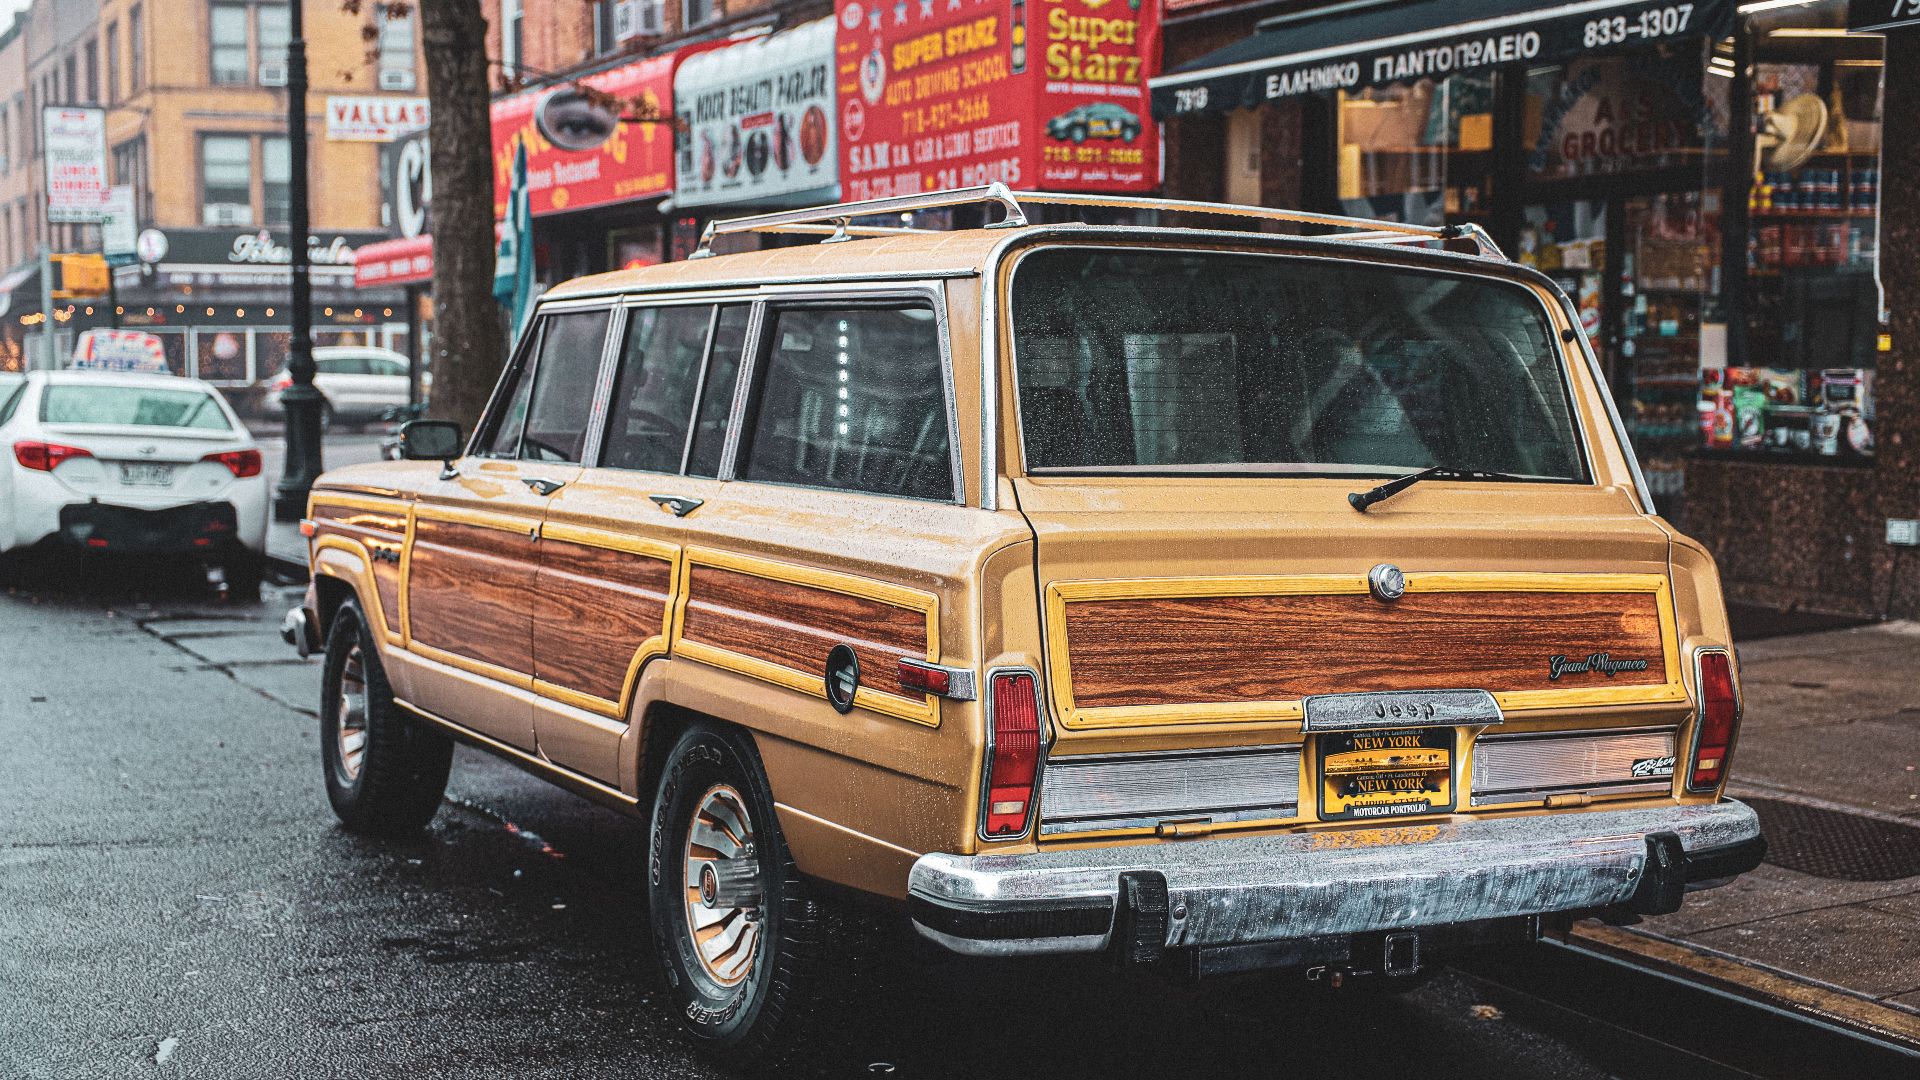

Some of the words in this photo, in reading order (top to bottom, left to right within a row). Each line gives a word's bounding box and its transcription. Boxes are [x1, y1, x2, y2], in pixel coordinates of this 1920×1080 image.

[1047, 7, 1139, 50] Super
[1583, 3, 1694, 48] 833-1307
[892, 32, 942, 71] SUPER
[946, 15, 998, 57] STARZ
[1045, 42, 1141, 82] Starz
[1549, 655, 1592, 680] Grand
[1591, 652, 1648, 678] Wagoneer
[1375, 701, 1435, 720] Jeep
[1354, 737, 1384, 750] NEW
[1388, 735, 1421, 748] YORK
[1358, 779, 1388, 793] NEW
[1392, 777, 1424, 790] YORK
[1353, 805, 1390, 817] MOTORCAR
[1390, 803, 1427, 815] PORTFOLIO
